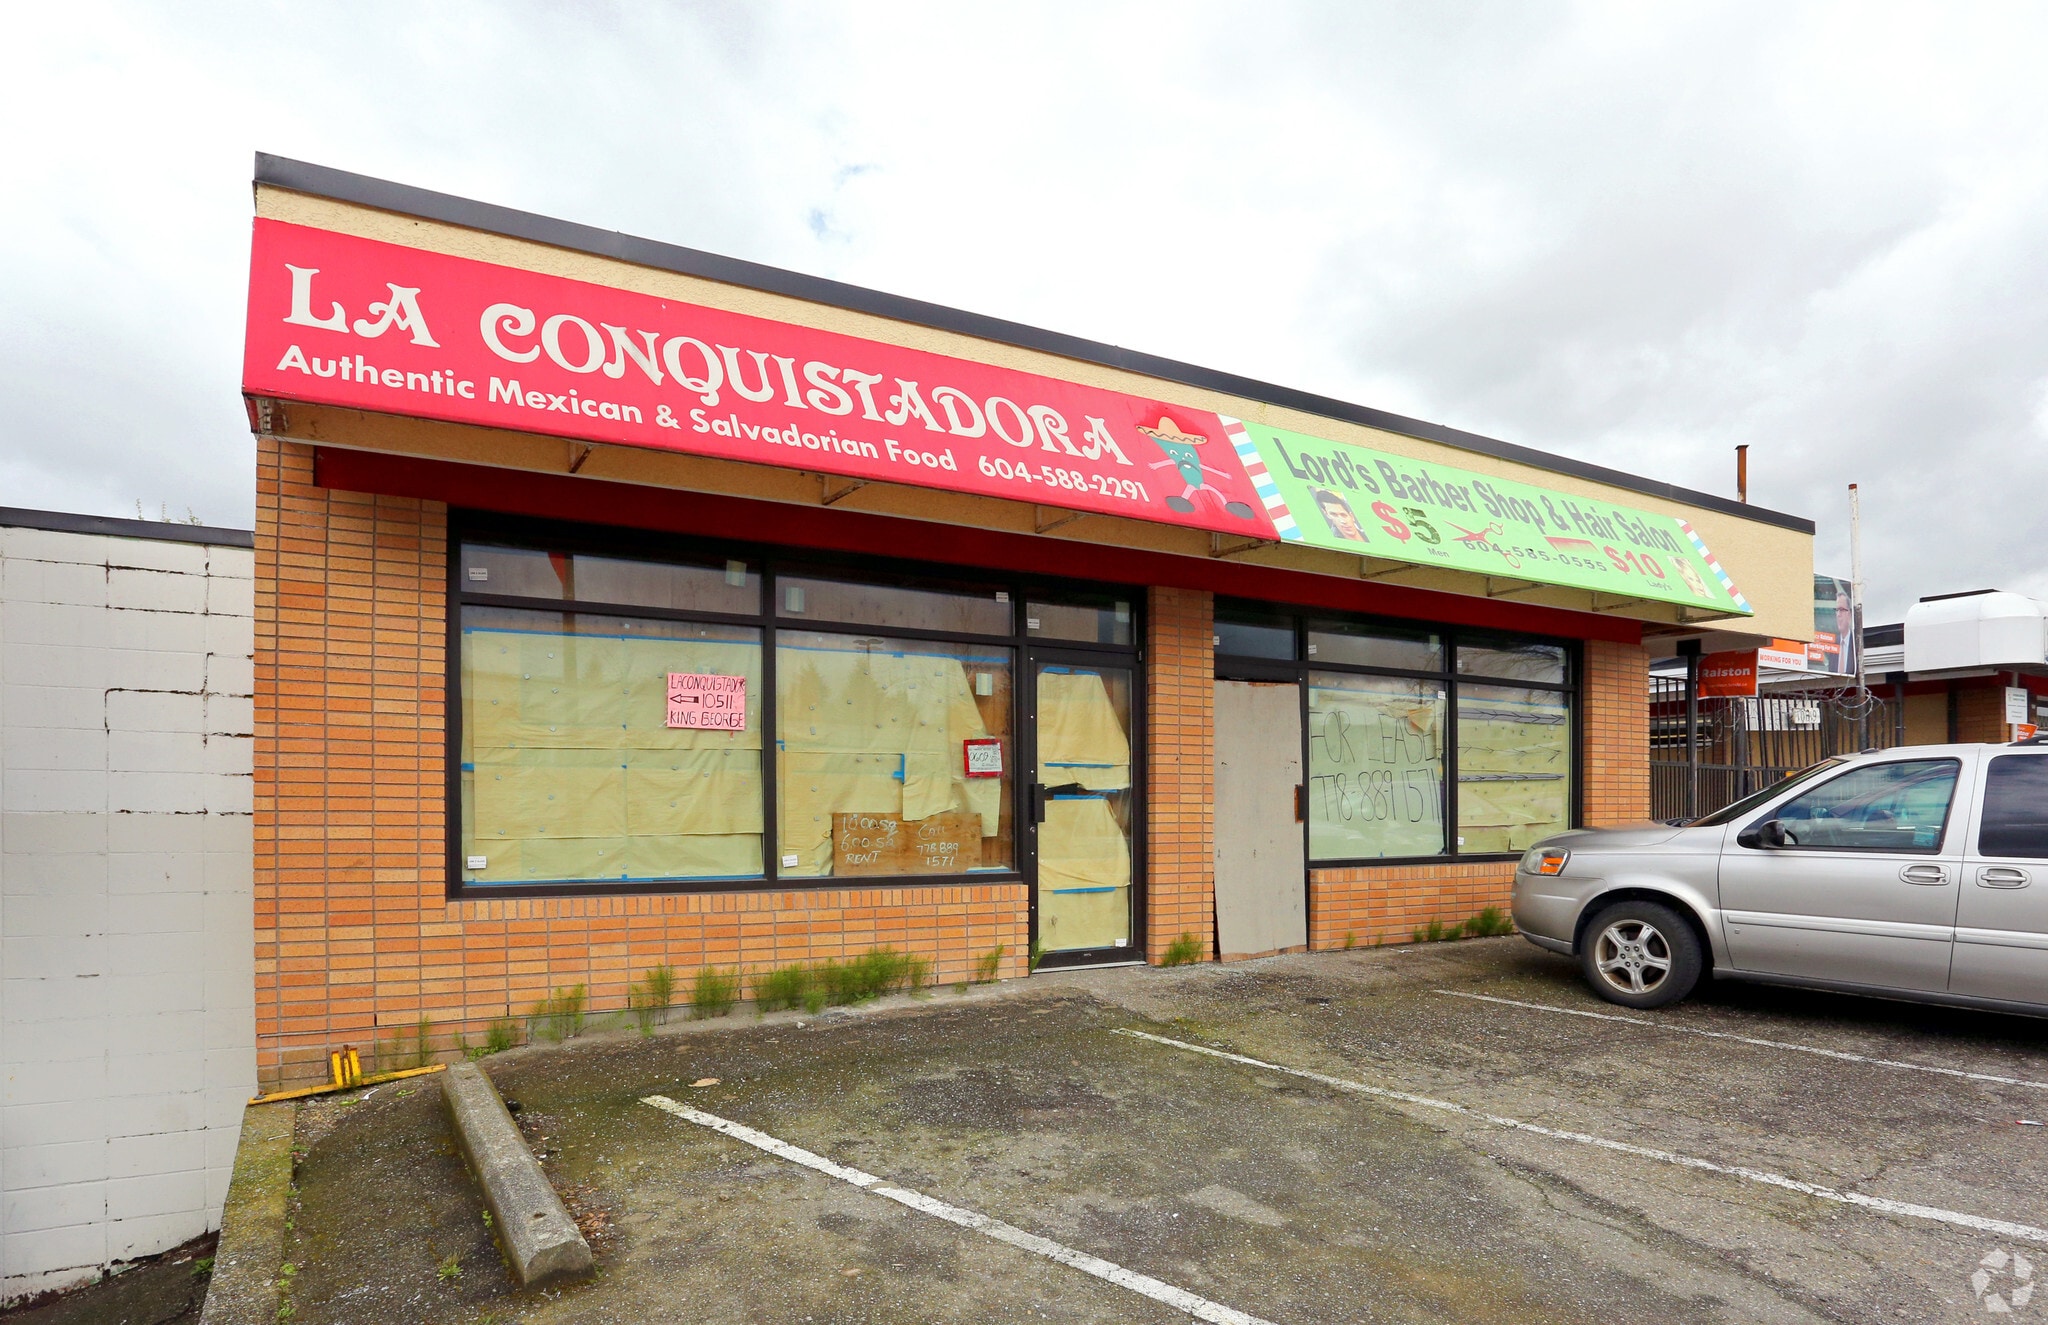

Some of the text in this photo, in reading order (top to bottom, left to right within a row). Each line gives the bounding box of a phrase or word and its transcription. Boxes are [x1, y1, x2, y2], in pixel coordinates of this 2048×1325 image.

[283, 263, 1134, 466] LA CONQUISTADORA
[277, 344, 1151, 502] Authentic Mexican & Salvadorian Food 604-588-2291
[1273, 437, 1684, 554] Lord's Barber Shop & Hair Salon
[1371, 500, 1442, 545] $5
[1427, 547, 1450, 558] Men
[1602, 544, 1666, 580] $10
[1645, 578, 1673, 592] Lady's
[1782, 657, 1792, 665] FOR
[1792, 658, 1802, 666] YOU
[1702, 667, 1751, 678] Ralston
[702, 693, 733, 709] 10511
[670, 710, 744, 728] KING GEORGE
[1309, 711, 1436, 764] FOR LEASE
[917, 842, 959, 856] 778 889
[845, 850, 882, 865] RENT
[926, 856, 955, 867] 1571
